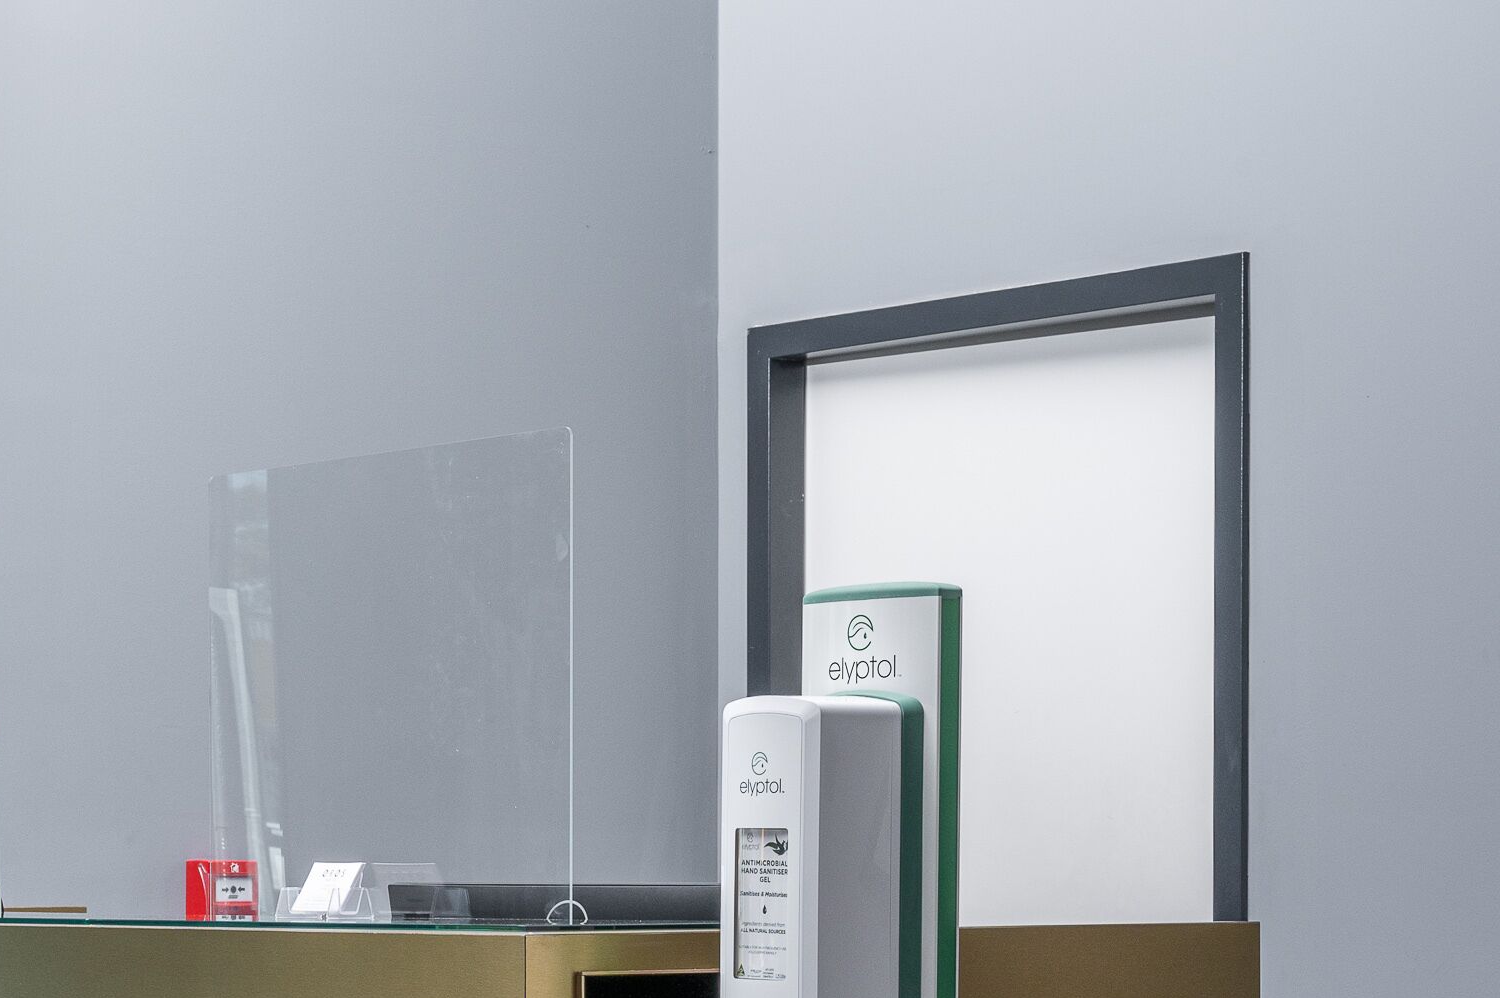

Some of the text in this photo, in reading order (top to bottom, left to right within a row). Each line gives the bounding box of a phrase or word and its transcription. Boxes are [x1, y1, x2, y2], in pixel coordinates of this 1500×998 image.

[741, 859, 788, 867] ANTIMICROBIAL
[741, 867, 788, 876] HAND SANITISER
